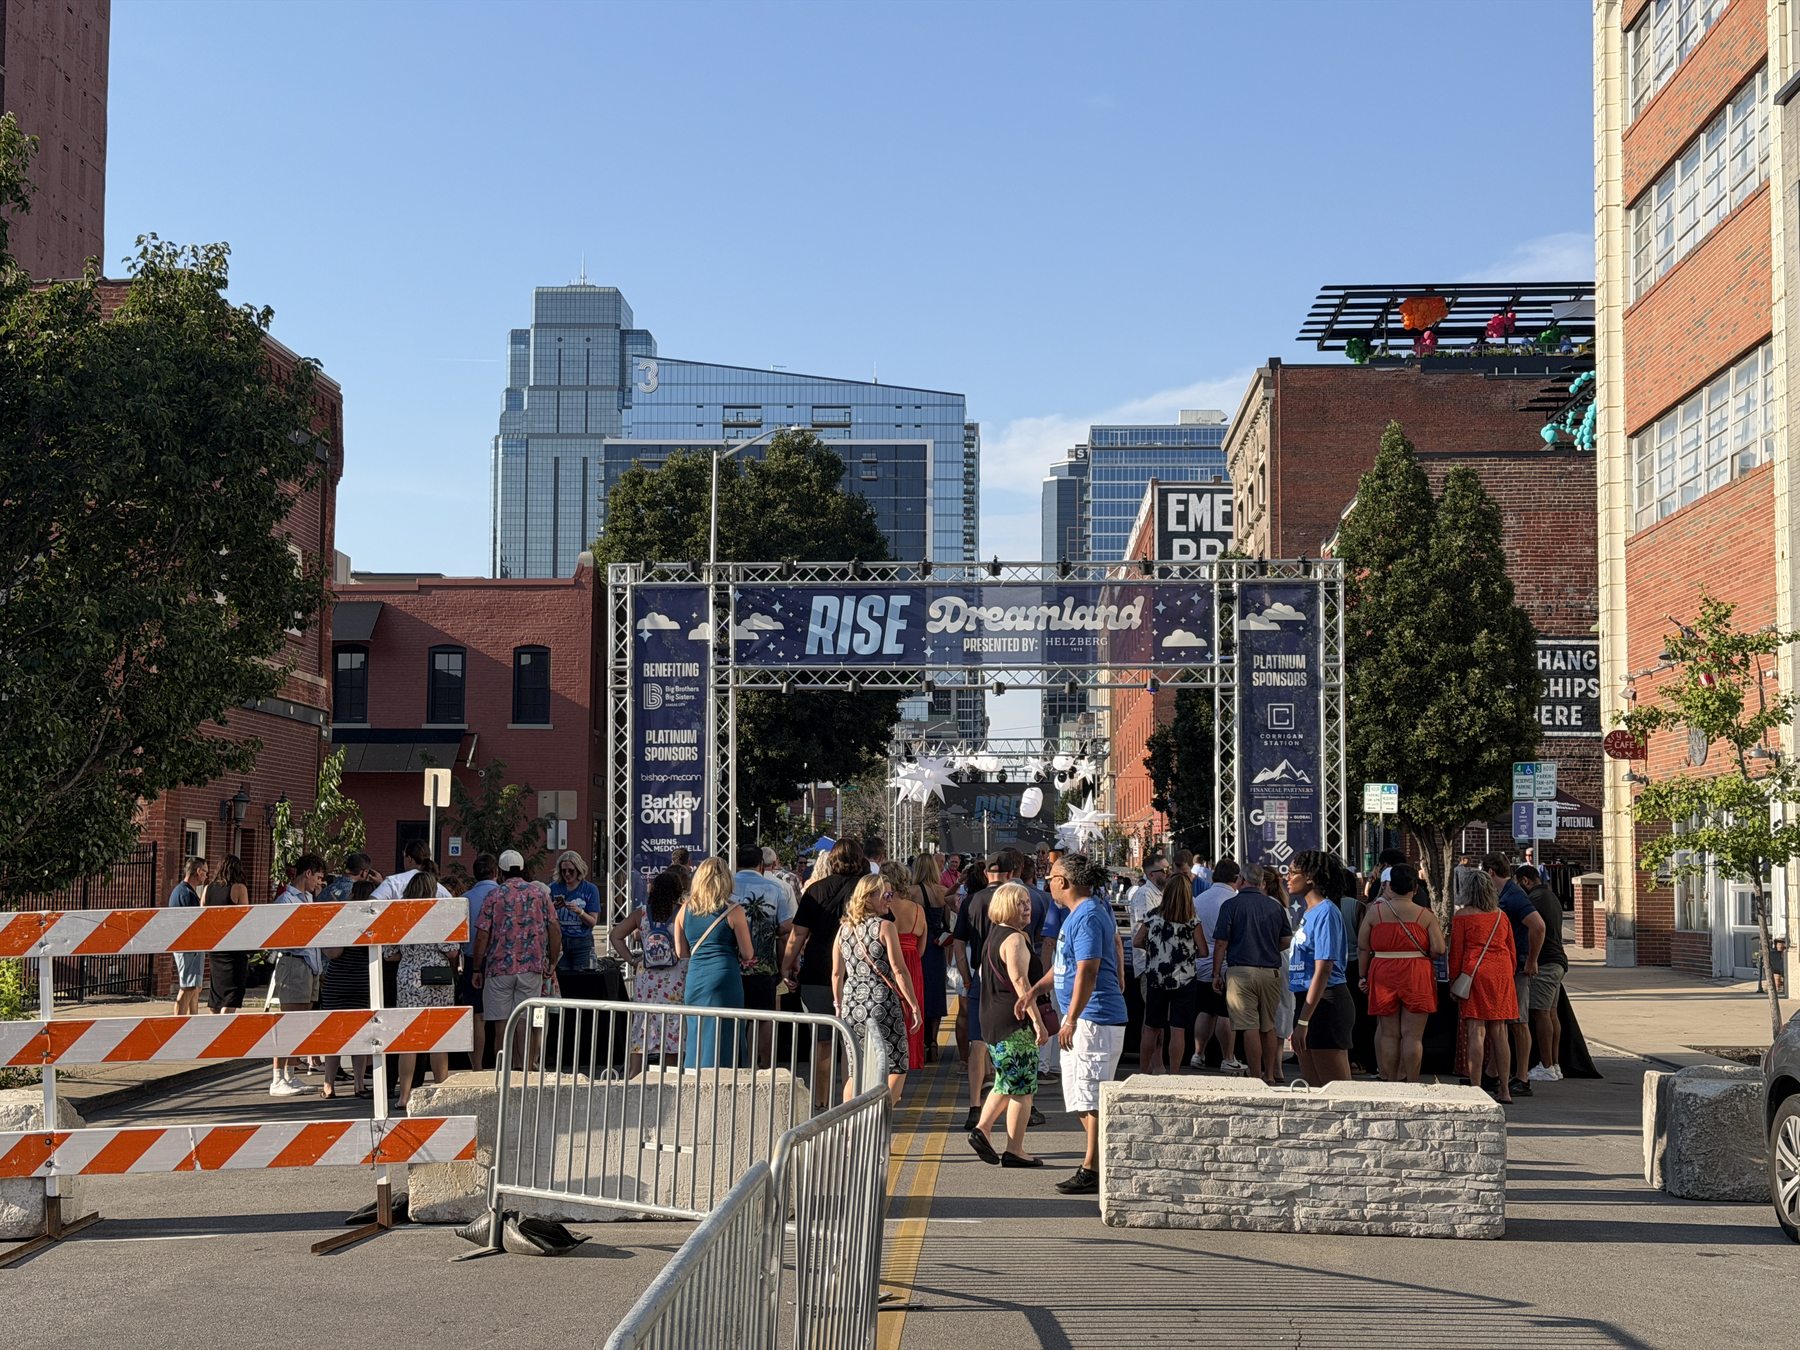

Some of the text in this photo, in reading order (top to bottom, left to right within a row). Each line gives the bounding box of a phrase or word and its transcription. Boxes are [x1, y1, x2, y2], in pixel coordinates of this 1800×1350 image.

[637, 359, 659, 393] 3
[805, 595, 1145, 655] RISE Dreamland
[963, 637, 1039, 652] PRESENTED BY:
[1045, 637, 1108, 646] HELZBERG
[1253, 654, 1306, 669] PLATINUM
[643, 662, 700, 677] BENEFITING
[1252, 672, 1308, 687] SPONSORS
[665, 685, 675, 694] Big
[665, 693, 675, 702] Big
[646, 730, 697, 744] PLATINUM
[1614, 741, 1635, 749] CAFE
[645, 747, 698, 761] SPONSORS
[641, 794, 702, 811] Barkley
[641, 809, 690, 824] OKRP
[1520, 806, 1527, 814] 3
[1562, 817, 1595, 828] POTENTIAL
